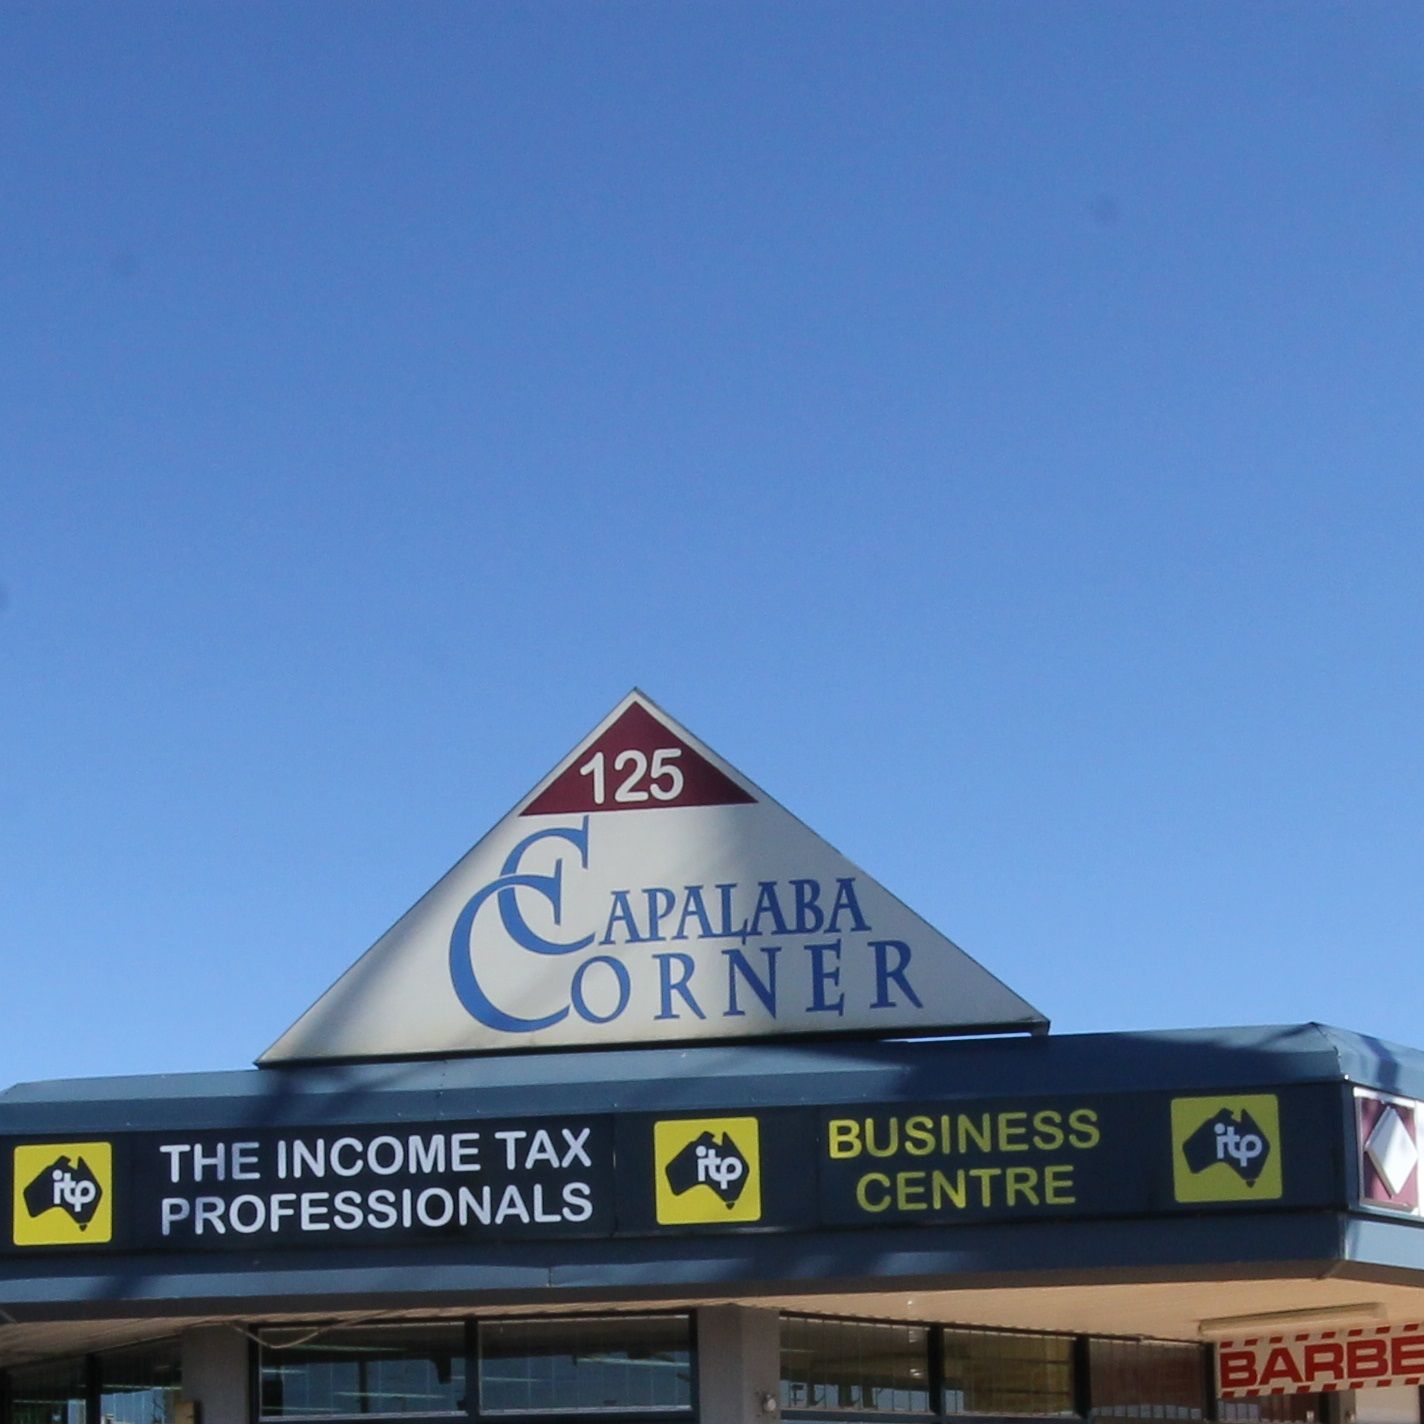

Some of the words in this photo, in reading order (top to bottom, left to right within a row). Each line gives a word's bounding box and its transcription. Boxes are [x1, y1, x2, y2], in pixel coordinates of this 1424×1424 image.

[580, 748, 685, 804] 125
[498, 814, 872, 955] CAPALABA
[449, 859, 923, 1033] CORNER
[159, 1141, 261, 1183] THE
[277, 1131, 480, 1179] INCOME
[494, 1127, 592, 1170] TAX
[828, 1108, 1101, 1159] BUSINESS
[1213, 1122, 1262, 1167] itp
[52, 1169, 96, 1213] itp
[695, 1145, 743, 1190] itp
[855, 1165, 1076, 1213] CENTRE
[161, 1182, 594, 1236] PROFESSIONALS
